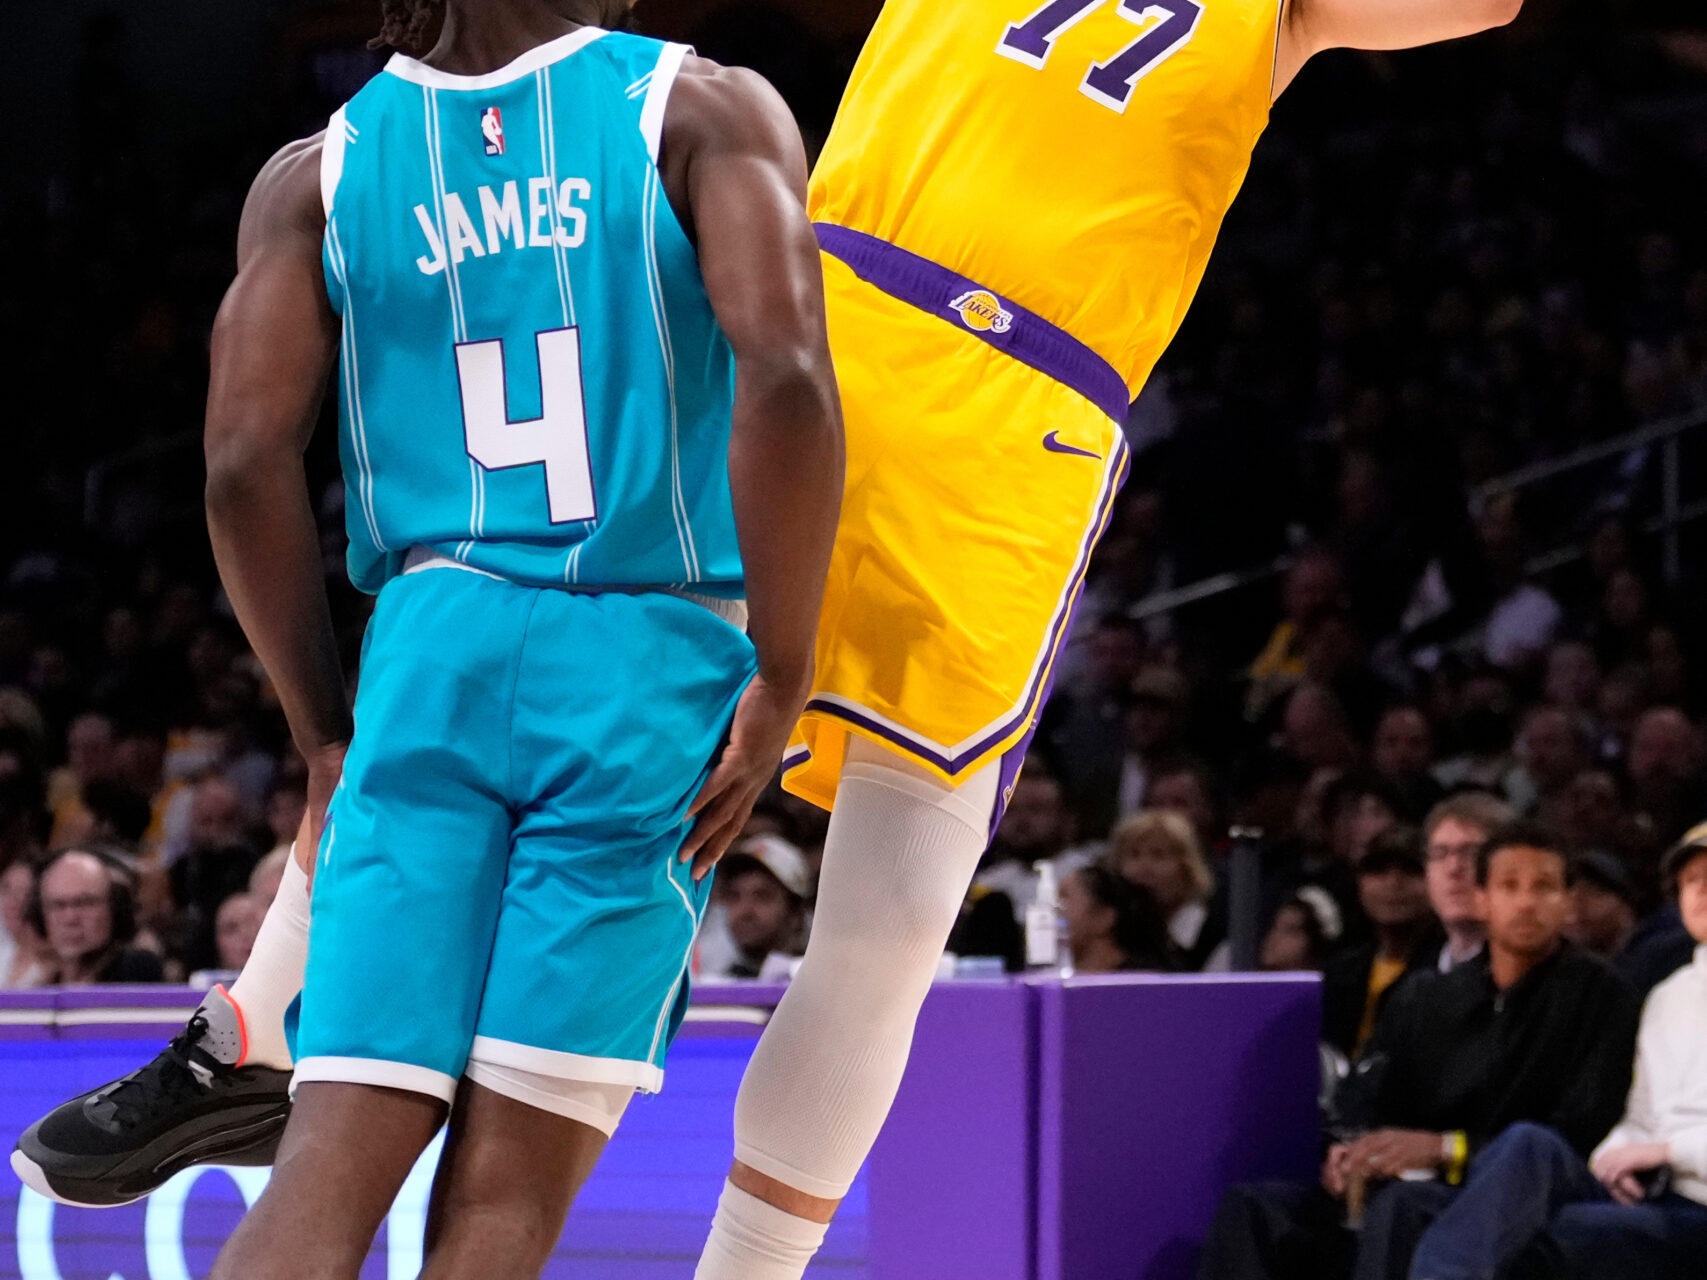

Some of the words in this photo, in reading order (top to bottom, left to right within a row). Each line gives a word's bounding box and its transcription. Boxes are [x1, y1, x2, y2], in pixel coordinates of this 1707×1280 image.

[414, 176, 592, 276] JAMES
[950, 293, 1012, 332] LAKERS
[453, 324, 598, 526] 4
